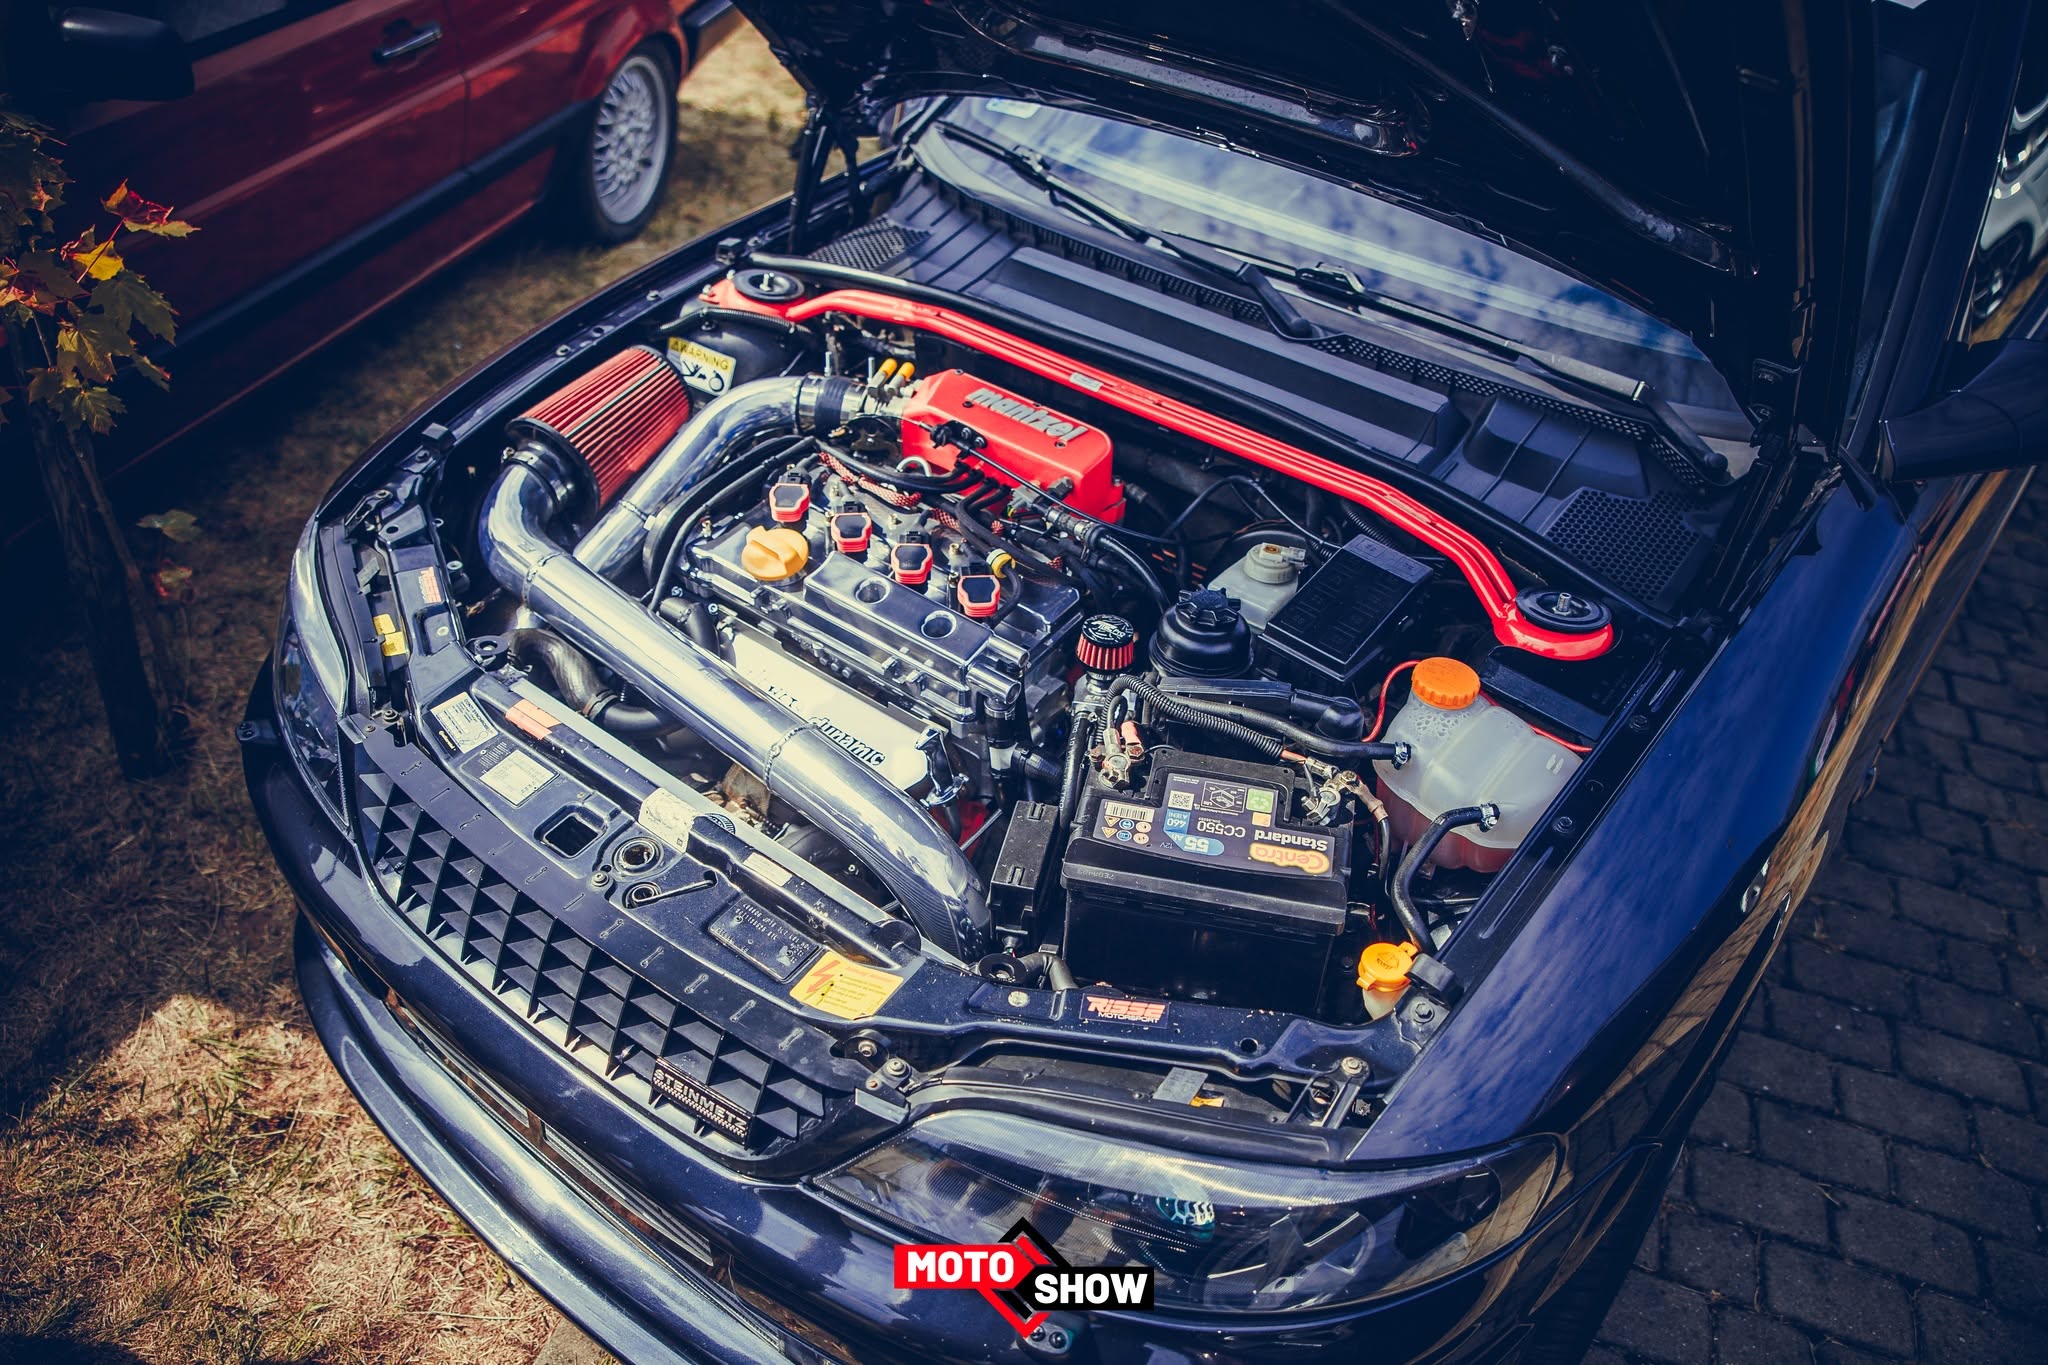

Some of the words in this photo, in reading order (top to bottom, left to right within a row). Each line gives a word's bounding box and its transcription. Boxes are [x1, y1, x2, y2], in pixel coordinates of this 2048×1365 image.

[680, 342, 729, 371] WARNING
[964, 387, 1088, 442] mantzel
[1166, 818, 1187, 829] 460
[1197, 820, 1246, 838] CC550
[1160, 841, 1174, 850] 12V
[1183, 837, 1209, 853] 55
[1254, 829, 1329, 851] Standard
[1255, 844, 1325, 871] Centra
[1097, 1011, 1160, 1024] MOTORSPORT
[653, 1068, 748, 1131] STEINMETZ
